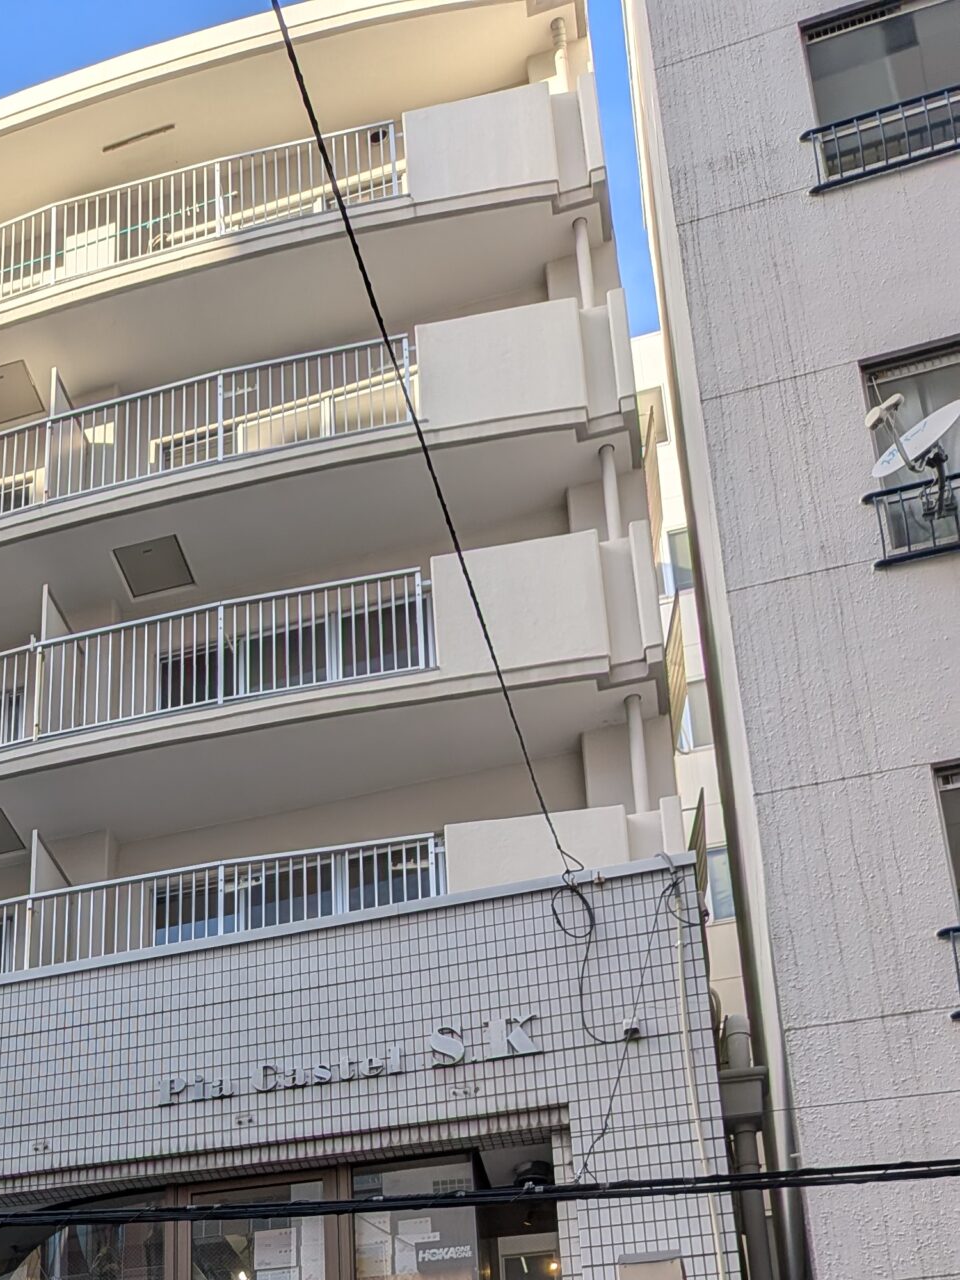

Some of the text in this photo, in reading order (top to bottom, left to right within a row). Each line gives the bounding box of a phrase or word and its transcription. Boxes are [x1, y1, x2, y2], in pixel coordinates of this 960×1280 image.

[157, 1074, 235, 1107] Pia
[249, 1043, 403, 1093] Castel
[418, 1247, 457, 1263] HOKA
